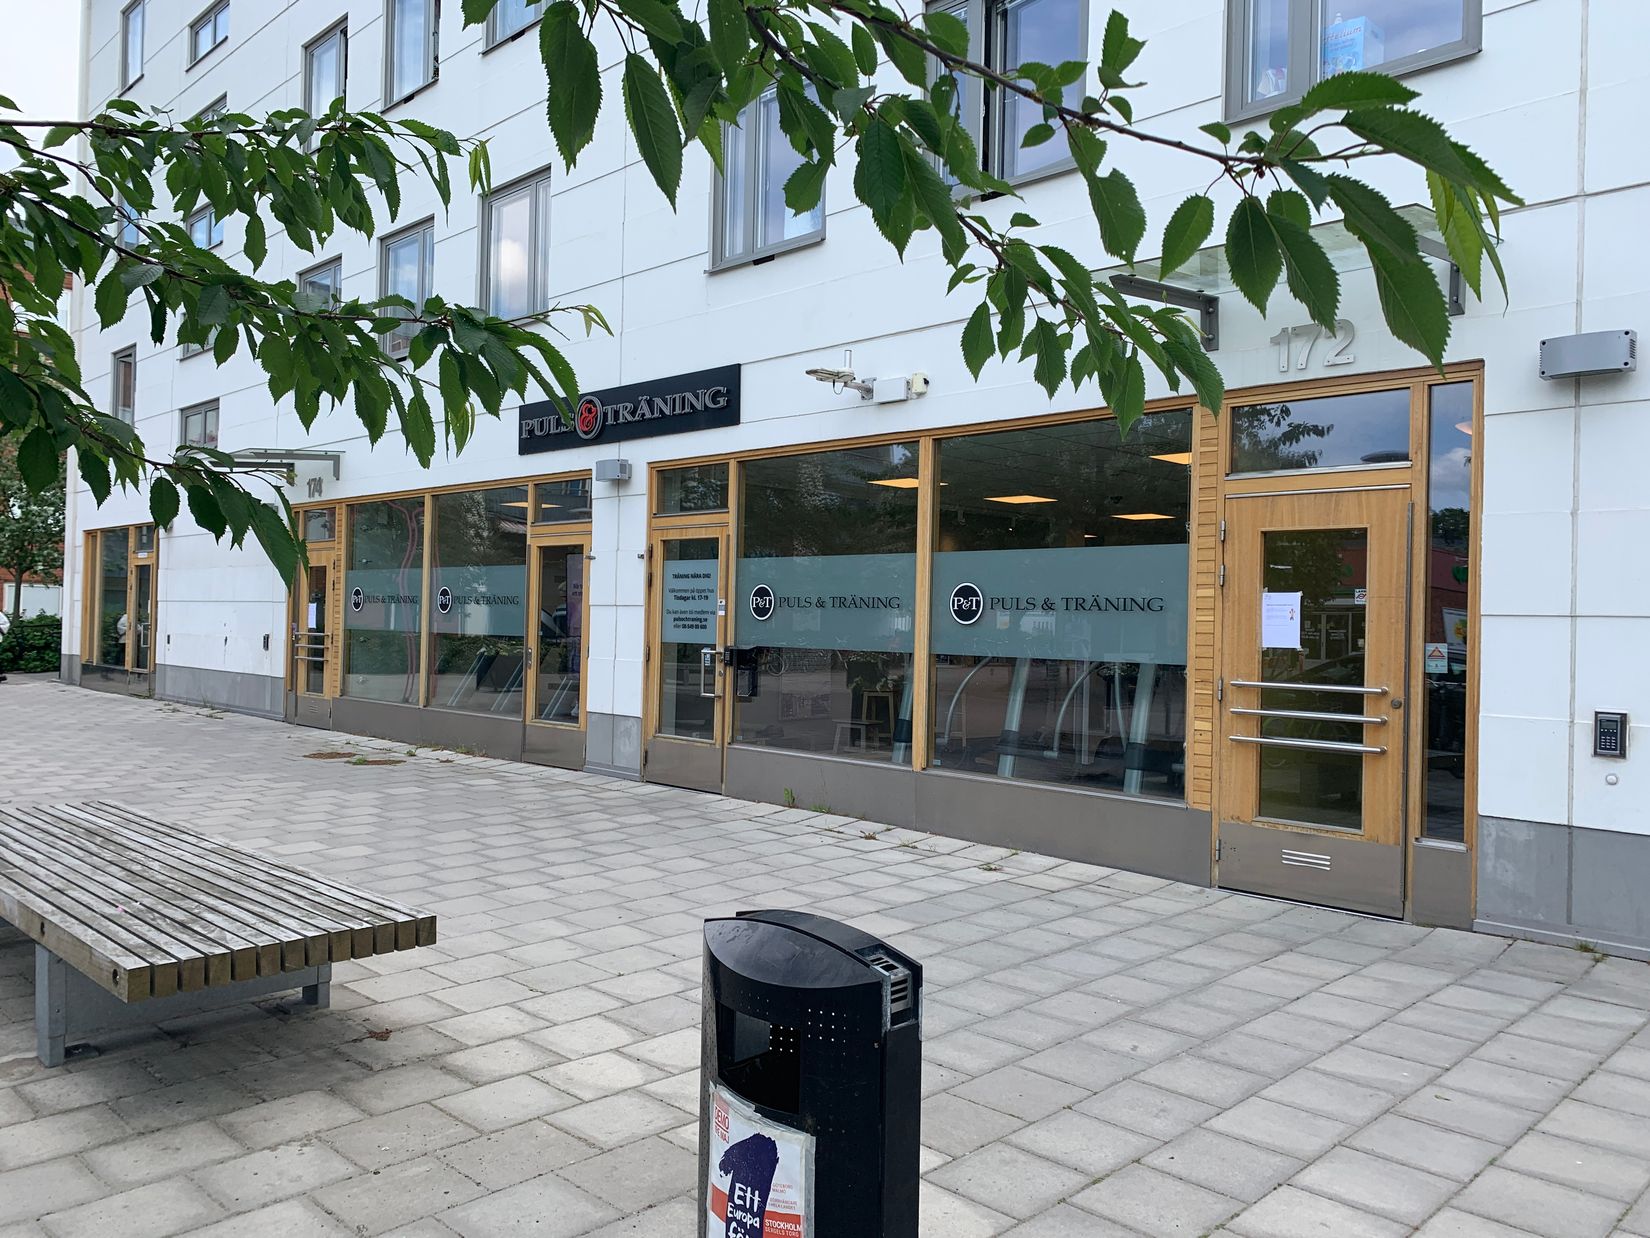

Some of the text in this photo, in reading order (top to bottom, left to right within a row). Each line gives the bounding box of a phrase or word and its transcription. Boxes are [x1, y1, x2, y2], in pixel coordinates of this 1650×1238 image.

[1269, 319, 1355, 372] 172
[603, 386, 728, 425] TRÄNING
[307, 476, 323, 498] 174
[364, 596, 381, 604] PULS
[386, 593, 419, 604] TRÄNING
[454, 595, 473, 604] PULS
[481, 593, 519, 606] TRÄNING
[752, 594, 901, 609] P&T PULS & TRÄNING
[952, 594, 1164, 612] P&T PULS & TRÄNING
[734, 1183, 761, 1212] Ett
[727, 1202, 760, 1230] Europa
[728, 1221, 751, 1238] fö
[765, 1219, 802, 1232] STOCKHOLM
